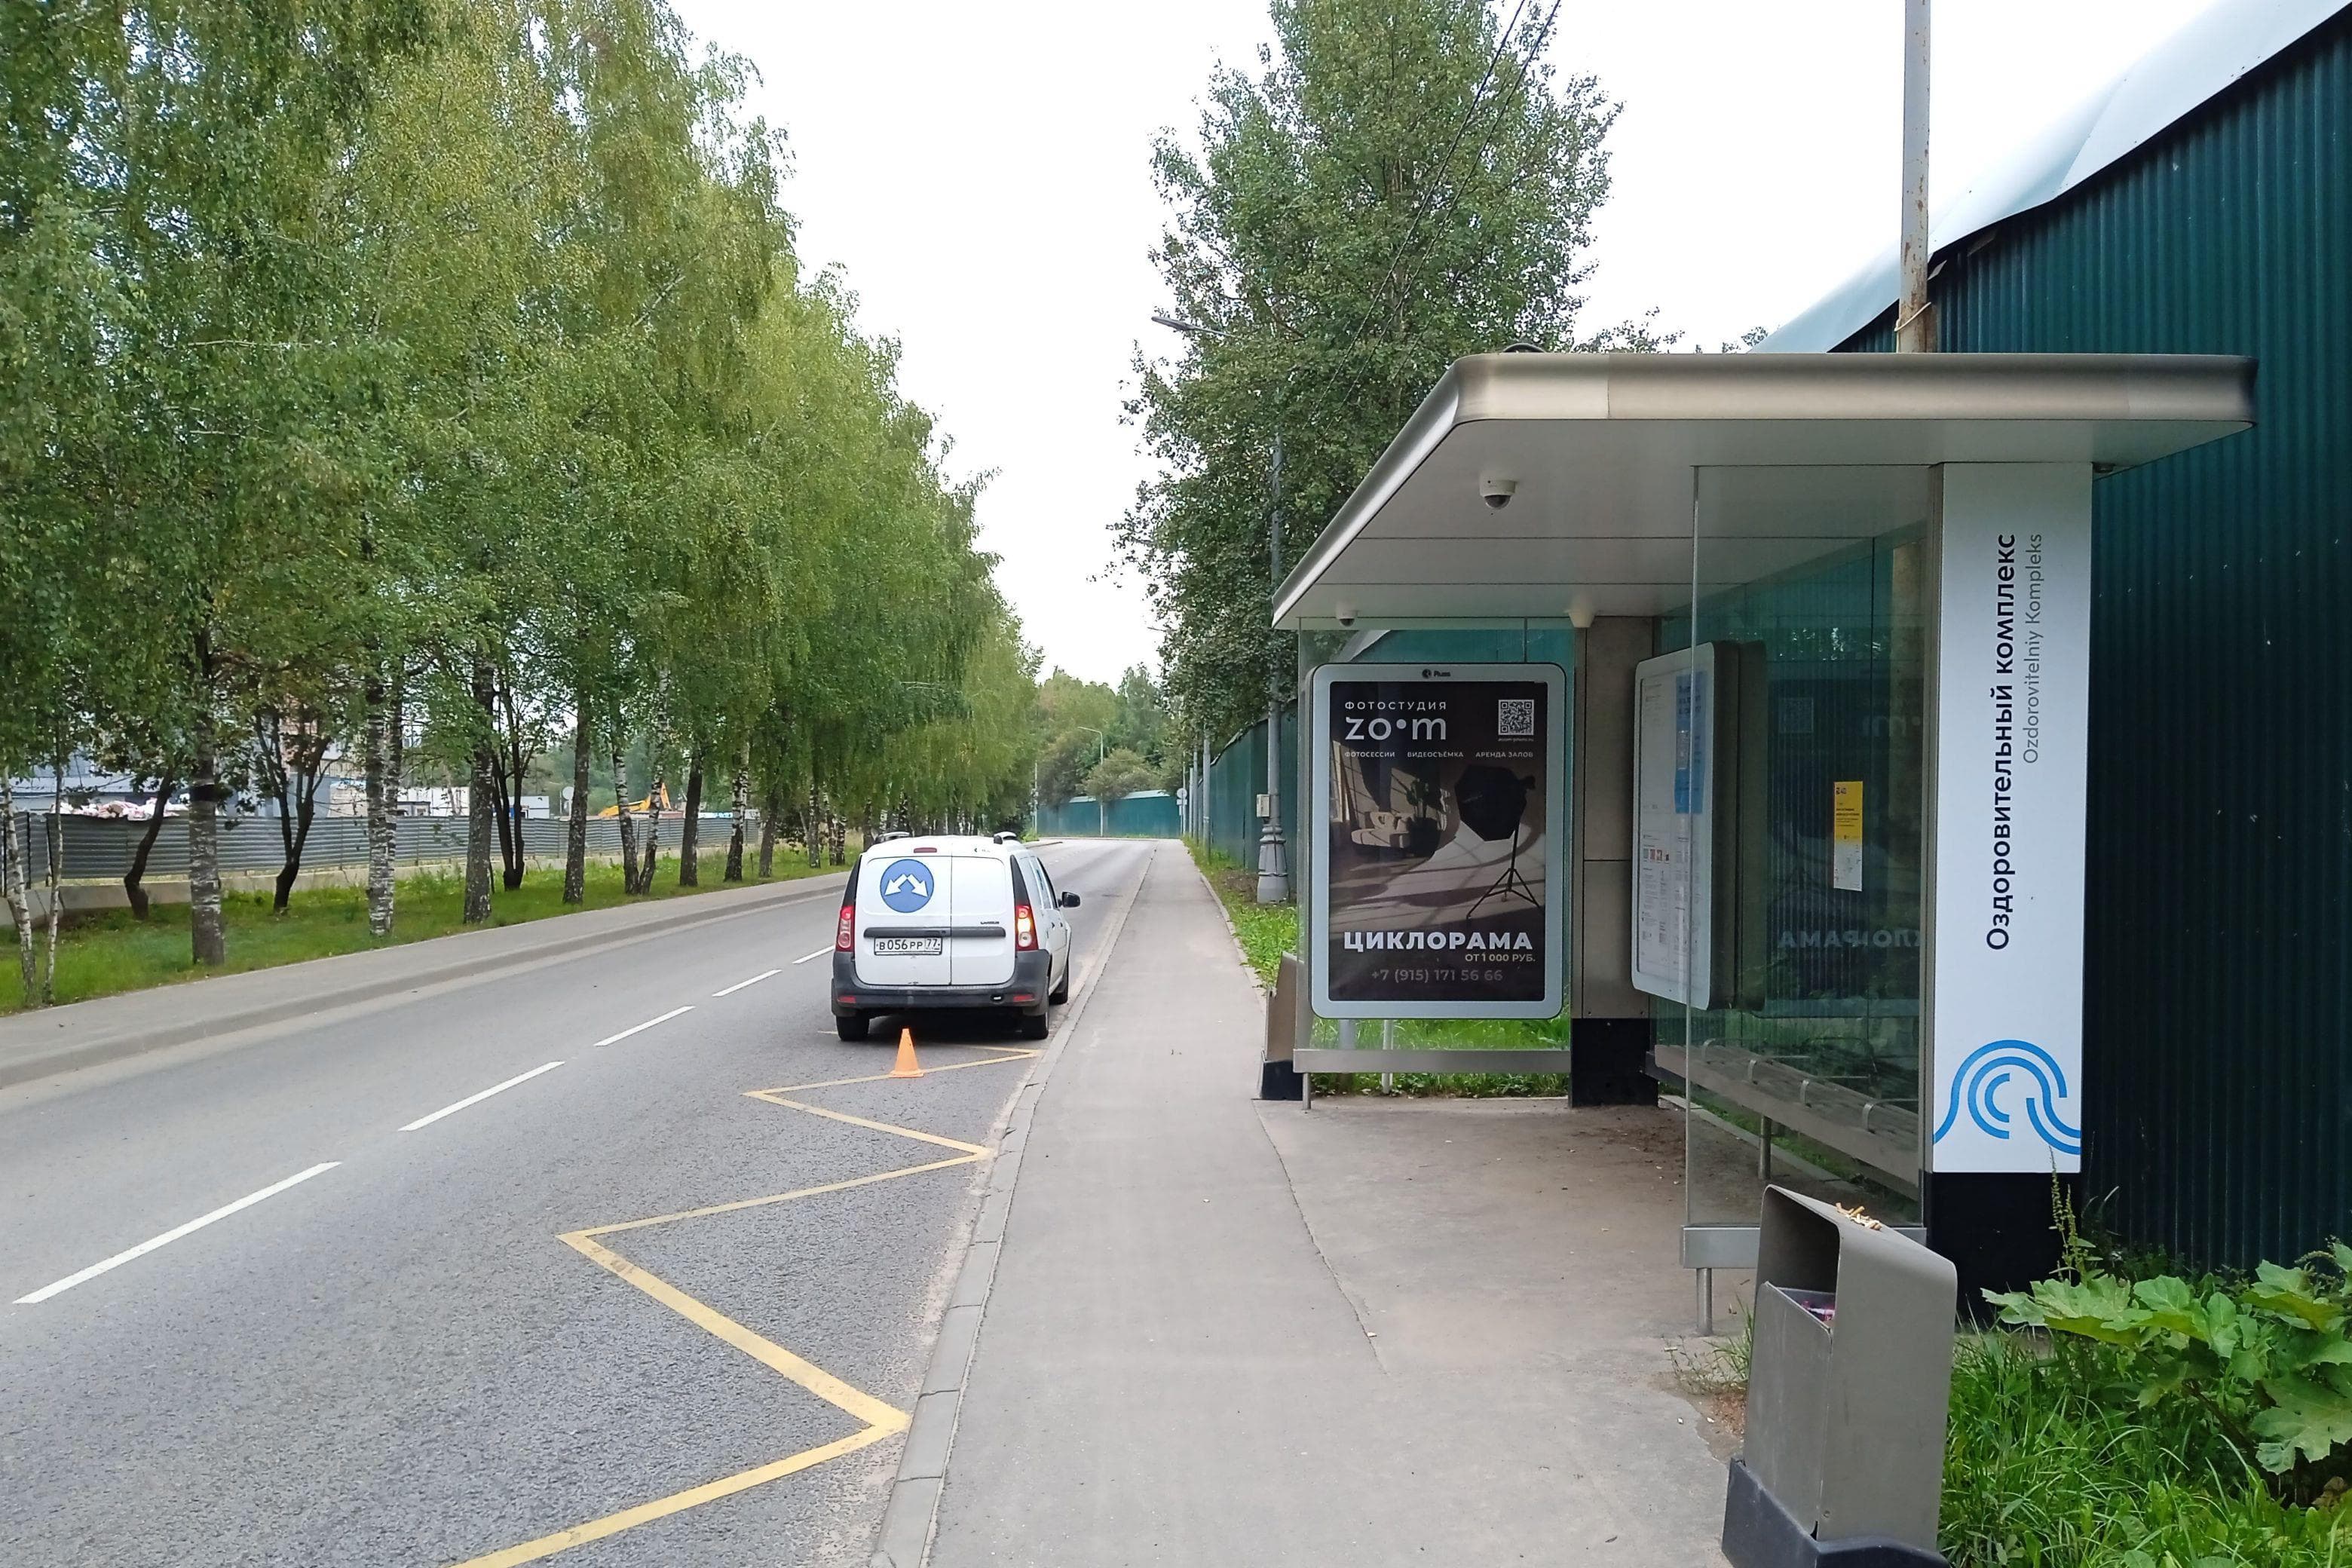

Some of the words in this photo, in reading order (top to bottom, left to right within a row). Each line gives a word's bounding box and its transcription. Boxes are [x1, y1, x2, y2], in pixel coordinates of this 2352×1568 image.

[1996, 534, 2016, 674] комплекс
[2025, 534, 2044, 625] Kompleks
[1345, 701, 1447, 711] ФОТОСТУДИЯ
[2023, 630, 2044, 764] Ozdorovitelniy
[1986, 684, 2016, 950] Оздоровительный
[1343, 932, 1533, 953] ЦИКЛОРАМА
[1465, 954, 1480, 962] ОТ
[1512, 954, 1536, 963] РУБ.
[1371, 969, 1389, 981] +7
[1395, 969, 1429, 984] (915)
[1434, 969, 1456, 981] 171
[1461, 969, 1479, 981] 56
[1484, 969, 1503, 981] 66
